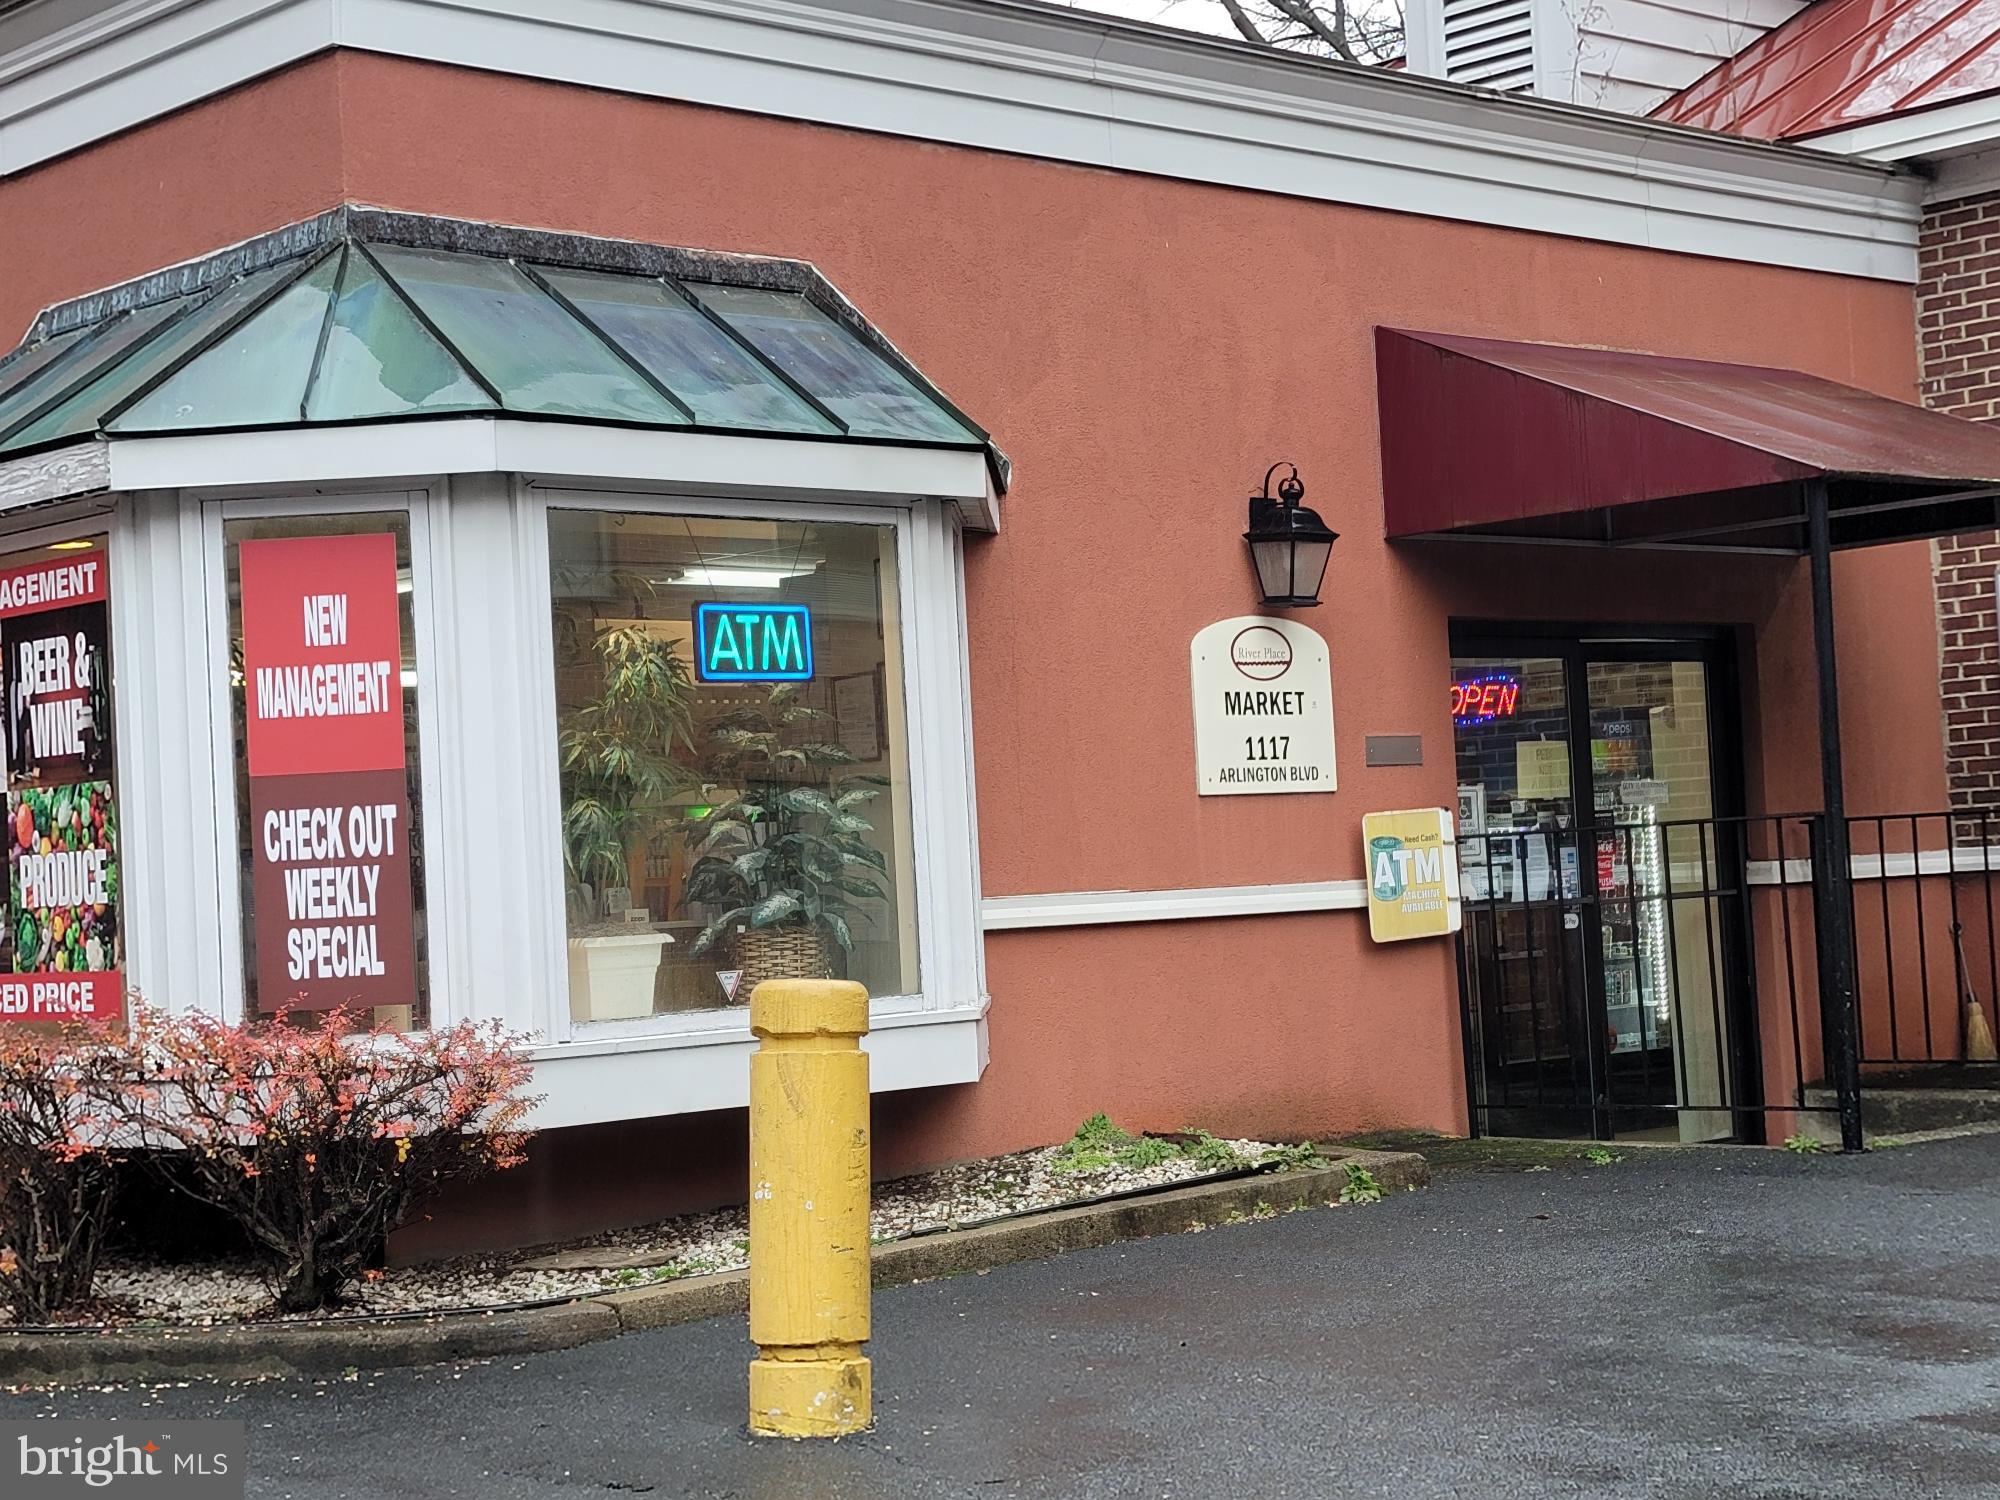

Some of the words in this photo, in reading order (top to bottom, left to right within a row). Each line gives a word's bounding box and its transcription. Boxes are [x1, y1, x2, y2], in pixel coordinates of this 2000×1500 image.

[303, 594, 347, 647] NEW
[710, 614, 803, 670] ATM
[20, 635, 71, 696] BEER
[74, 631, 91, 688] &
[1238, 648, 1261, 659] River
[1263, 647, 1286, 659] Place
[256, 661, 391, 719] MANAGEMENT
[1224, 691, 1304, 716] MARKET
[1450, 683, 1519, 715] OPEN
[30, 697, 86, 759] WINE
[1245, 736, 1290, 760] 1117
[1219, 767, 1287, 783] ARLINGTON
[1290, 766, 1319, 781] BLVD
[264, 807, 345, 862] CHECK
[348, 804, 397, 858] OUT
[1404, 835, 1420, 844] Need
[1420, 834, 1438, 842] Cash?
[20, 849, 108, 908] PRODUCE
[1373, 846, 1441, 889] ATM
[284, 865, 380, 920] WEEKLY
[1402, 900, 1443, 913] AVAILABLE
[1403, 888, 1440, 901] MACHINE
[287, 925, 385, 980] SPECIAL
[0, 983, 28, 1013] ED
[33, 981, 94, 1013] PRICE
